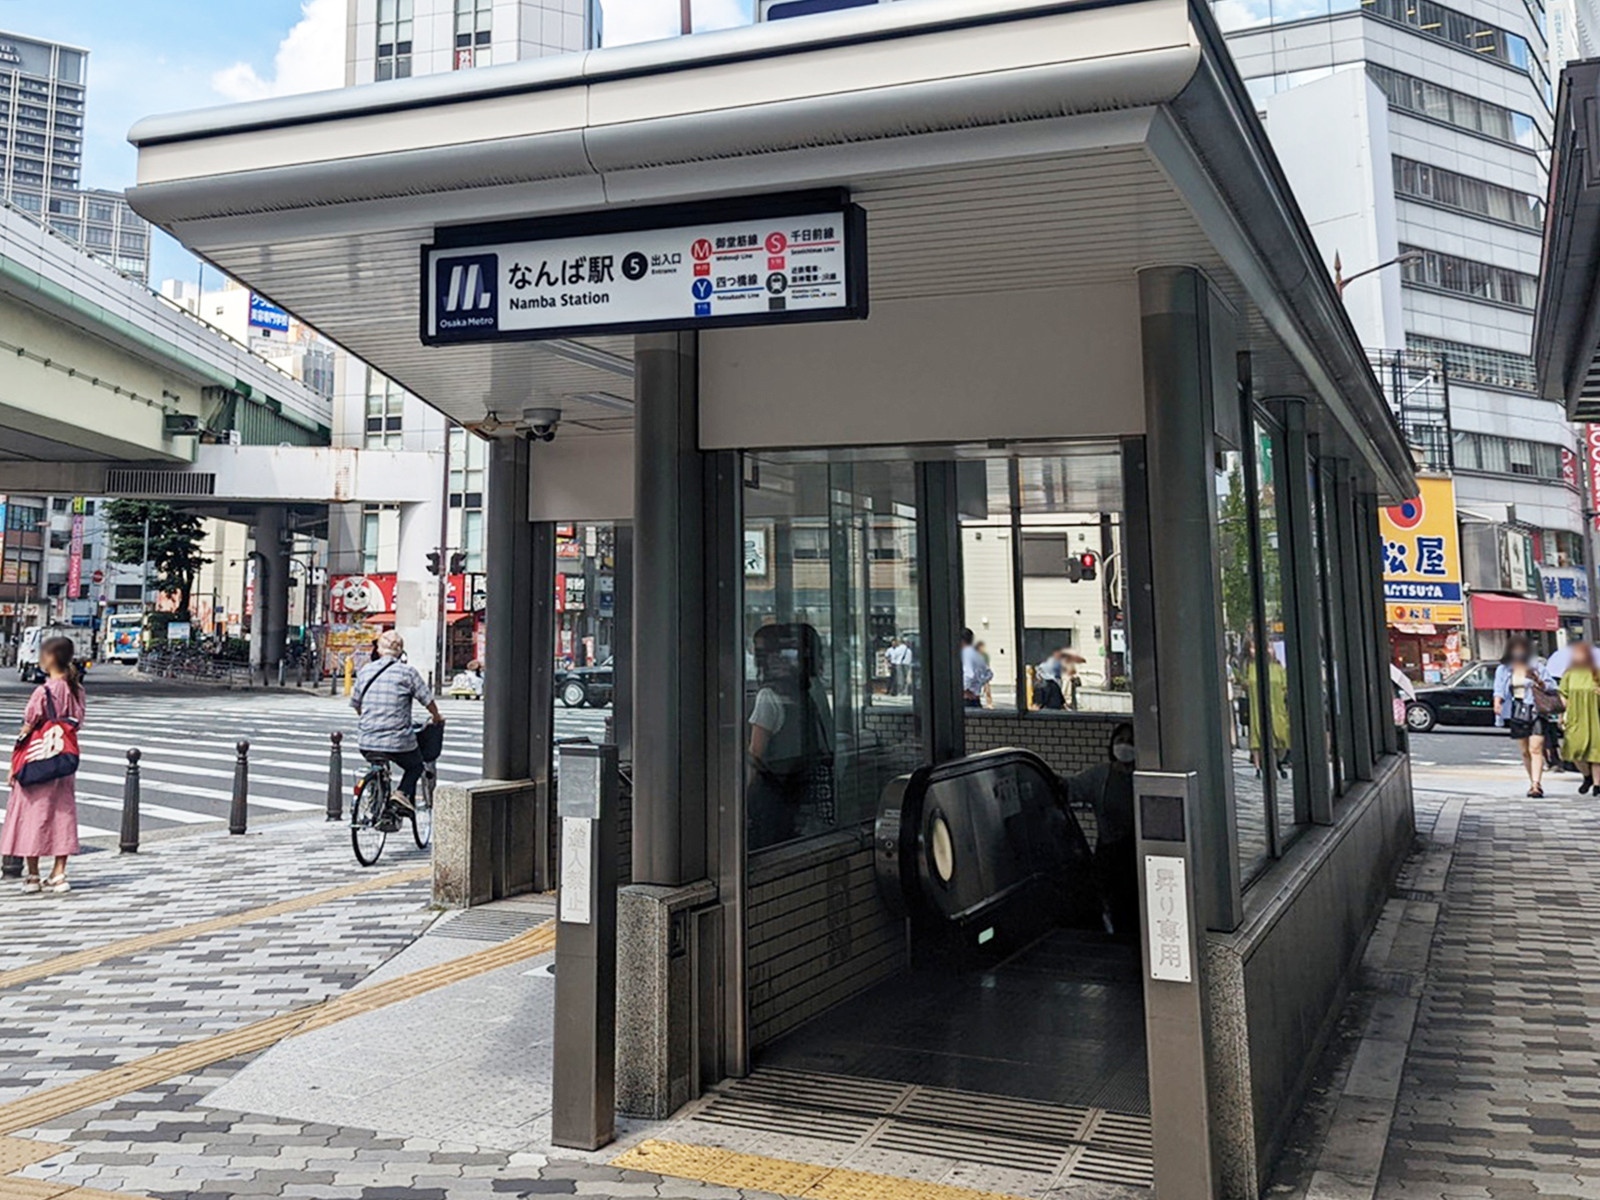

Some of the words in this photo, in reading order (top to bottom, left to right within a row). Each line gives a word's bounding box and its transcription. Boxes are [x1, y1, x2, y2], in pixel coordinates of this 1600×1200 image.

[716, 234, 758, 249] 御堂筋線
[791, 227, 834, 242] 千日前線
[694, 242, 709, 258] M
[771, 234, 781, 252] S
[651, 253, 681, 266] 出入口
[508, 255, 614, 290] なんば駅
[716, 273, 757, 288] 四つ橋線
[696, 281, 708, 298] Y
[509, 296, 557, 310] Namba
[560, 291, 610, 307] Station
[440, 318, 467, 328] Osaka
[467, 317, 494, 326] Metro
[1381, 536, 1446, 575] 松屋
